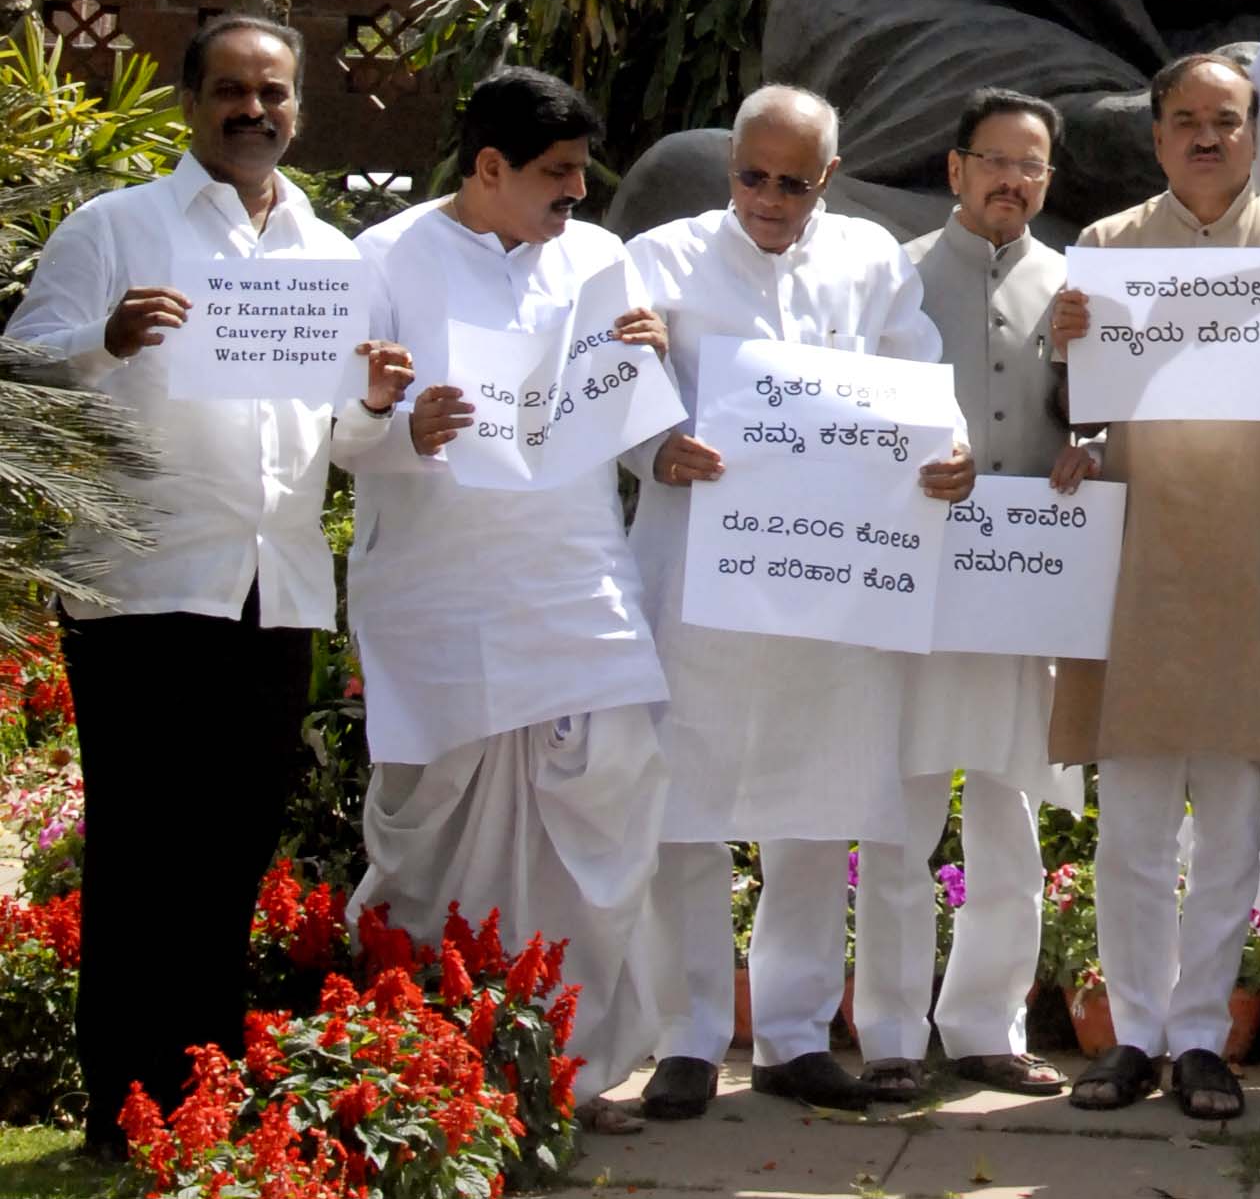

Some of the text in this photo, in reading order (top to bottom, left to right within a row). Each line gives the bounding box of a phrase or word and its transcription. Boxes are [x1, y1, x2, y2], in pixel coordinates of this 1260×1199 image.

[207, 278, 350, 291] We want Justice
[206, 303, 349, 316] for Karnataka in
[216, 326, 339, 342] Cauvery River
[1100, 321, 1184, 356] ನ್ಯಾಯ
[215, 349, 337, 365] Water Dispute
[478, 421, 515, 440] ಬರ
[582, 361, 638, 400] ಕೊಡಿ
[756, 375, 822, 407] ರೈತರ
[743, 422, 910, 462] ನಮ್ಮ ಕರ್ತವ್ಯ
[722, 510, 921, 550] ರೂ.2,606 ಕೋಟಿ
[946, 500, 1087, 537] ಮ್ಮ ಕಾವೇರಿ
[718, 555, 916, 594] ಬರ ಪರಿಹಾರ ಕೊಡಿ
[954, 548, 1063, 575] ನಮಗಿರಲಿ
